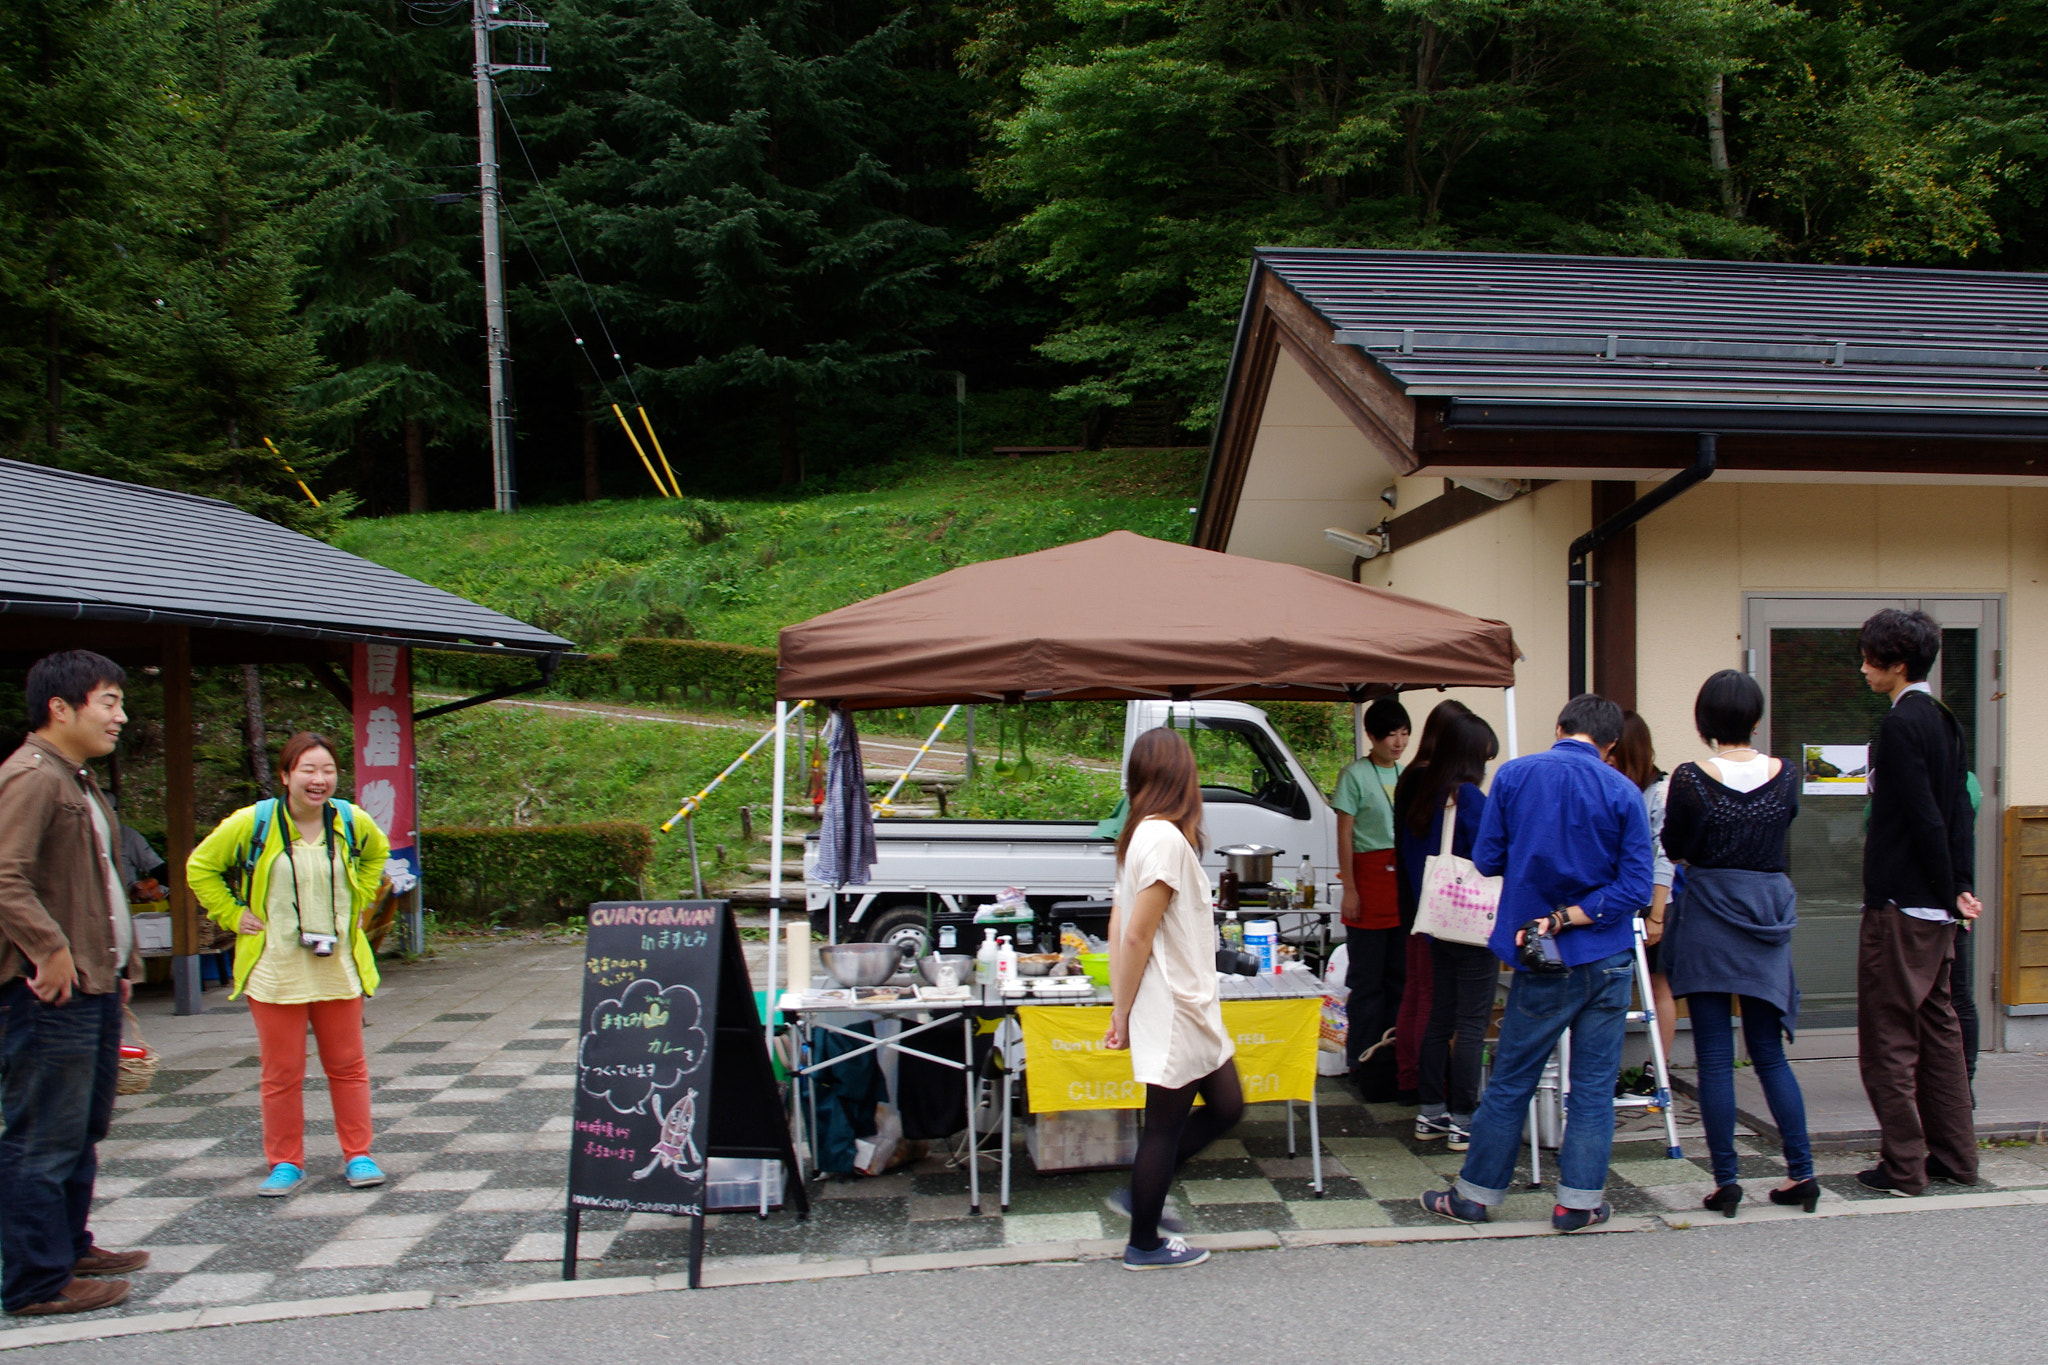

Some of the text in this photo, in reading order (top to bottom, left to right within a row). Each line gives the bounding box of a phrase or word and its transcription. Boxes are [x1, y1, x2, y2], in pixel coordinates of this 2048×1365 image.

[591, 906, 716, 926] CURRY CARAVAN
[641, 929, 708, 950] in ますとみ
[1051, 1038, 1092, 1053] Don't
[592, 1063, 657, 1079] つくっています
[1068, 1080, 1146, 1101] CURR
